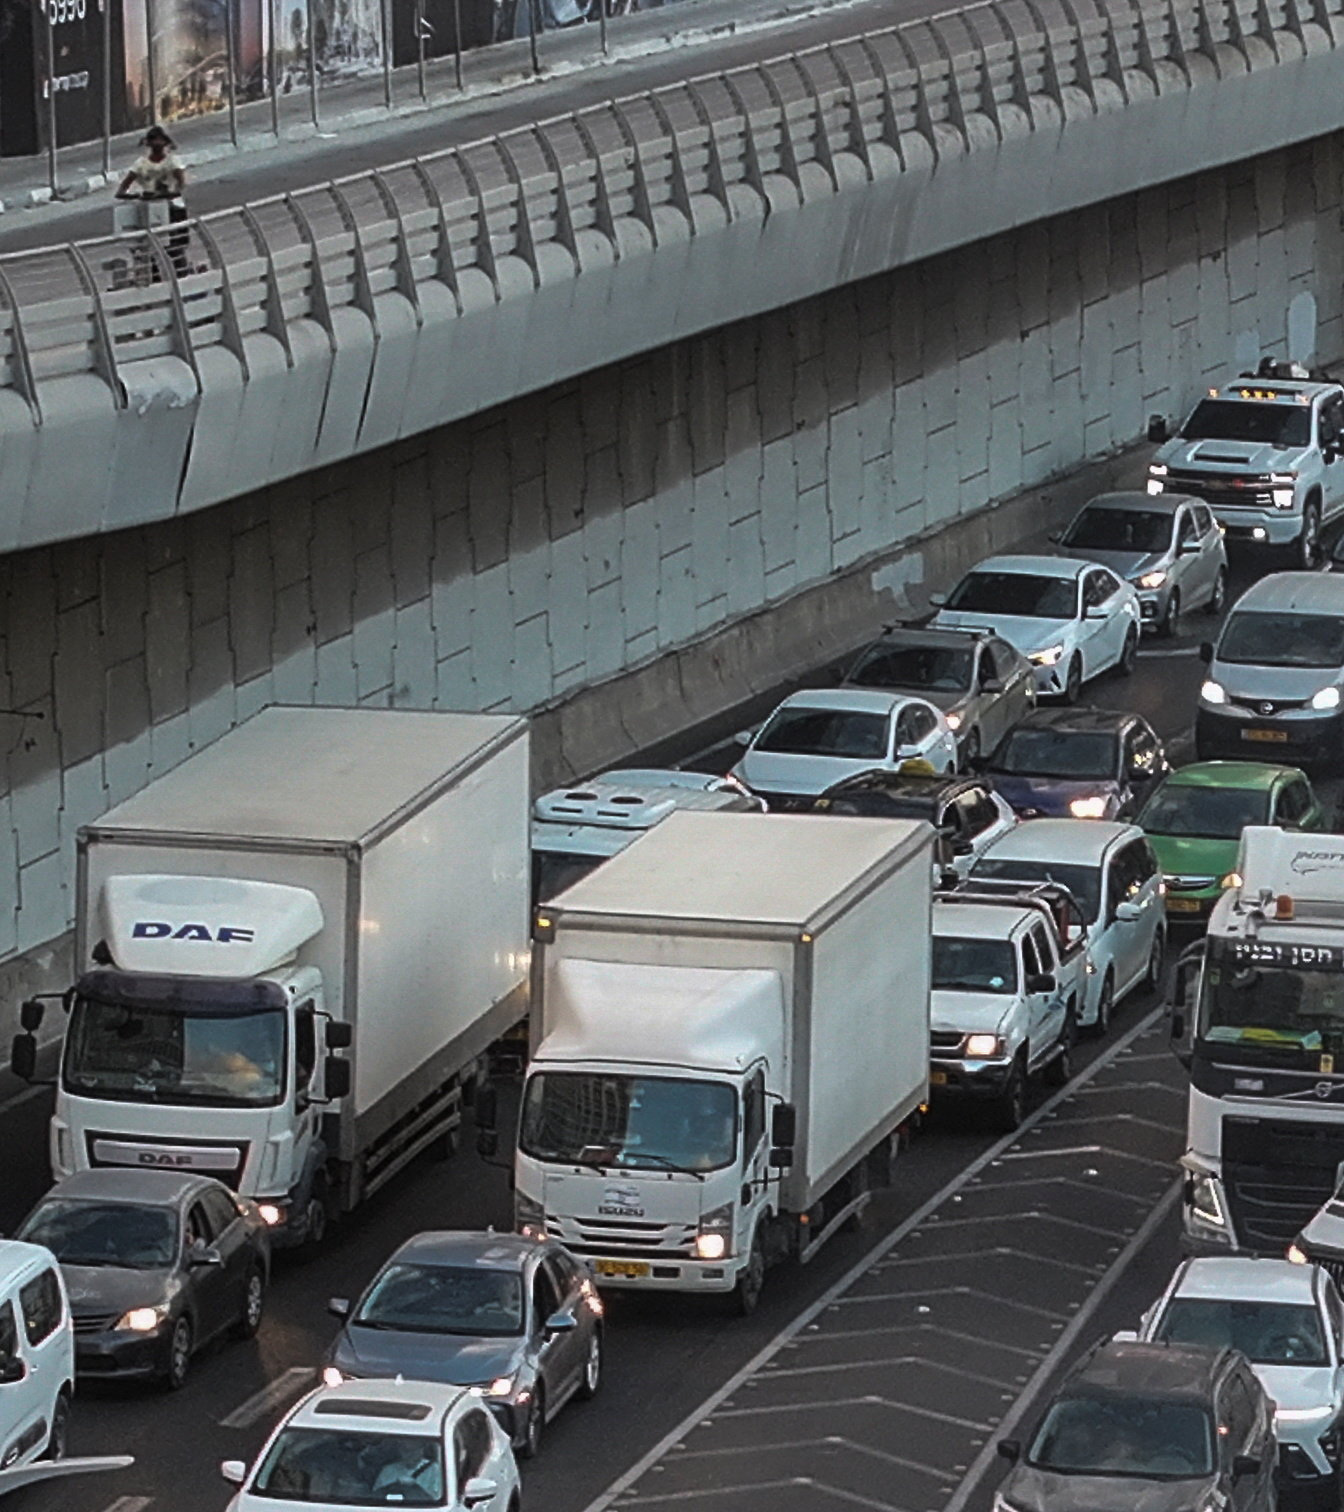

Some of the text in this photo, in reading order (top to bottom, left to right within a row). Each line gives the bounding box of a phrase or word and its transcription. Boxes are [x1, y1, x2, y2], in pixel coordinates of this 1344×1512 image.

[132, 921, 255, 944] DAF
[138, 1153, 193, 1167] DAF
[598, 1206, 644, 1217] ISUZU
